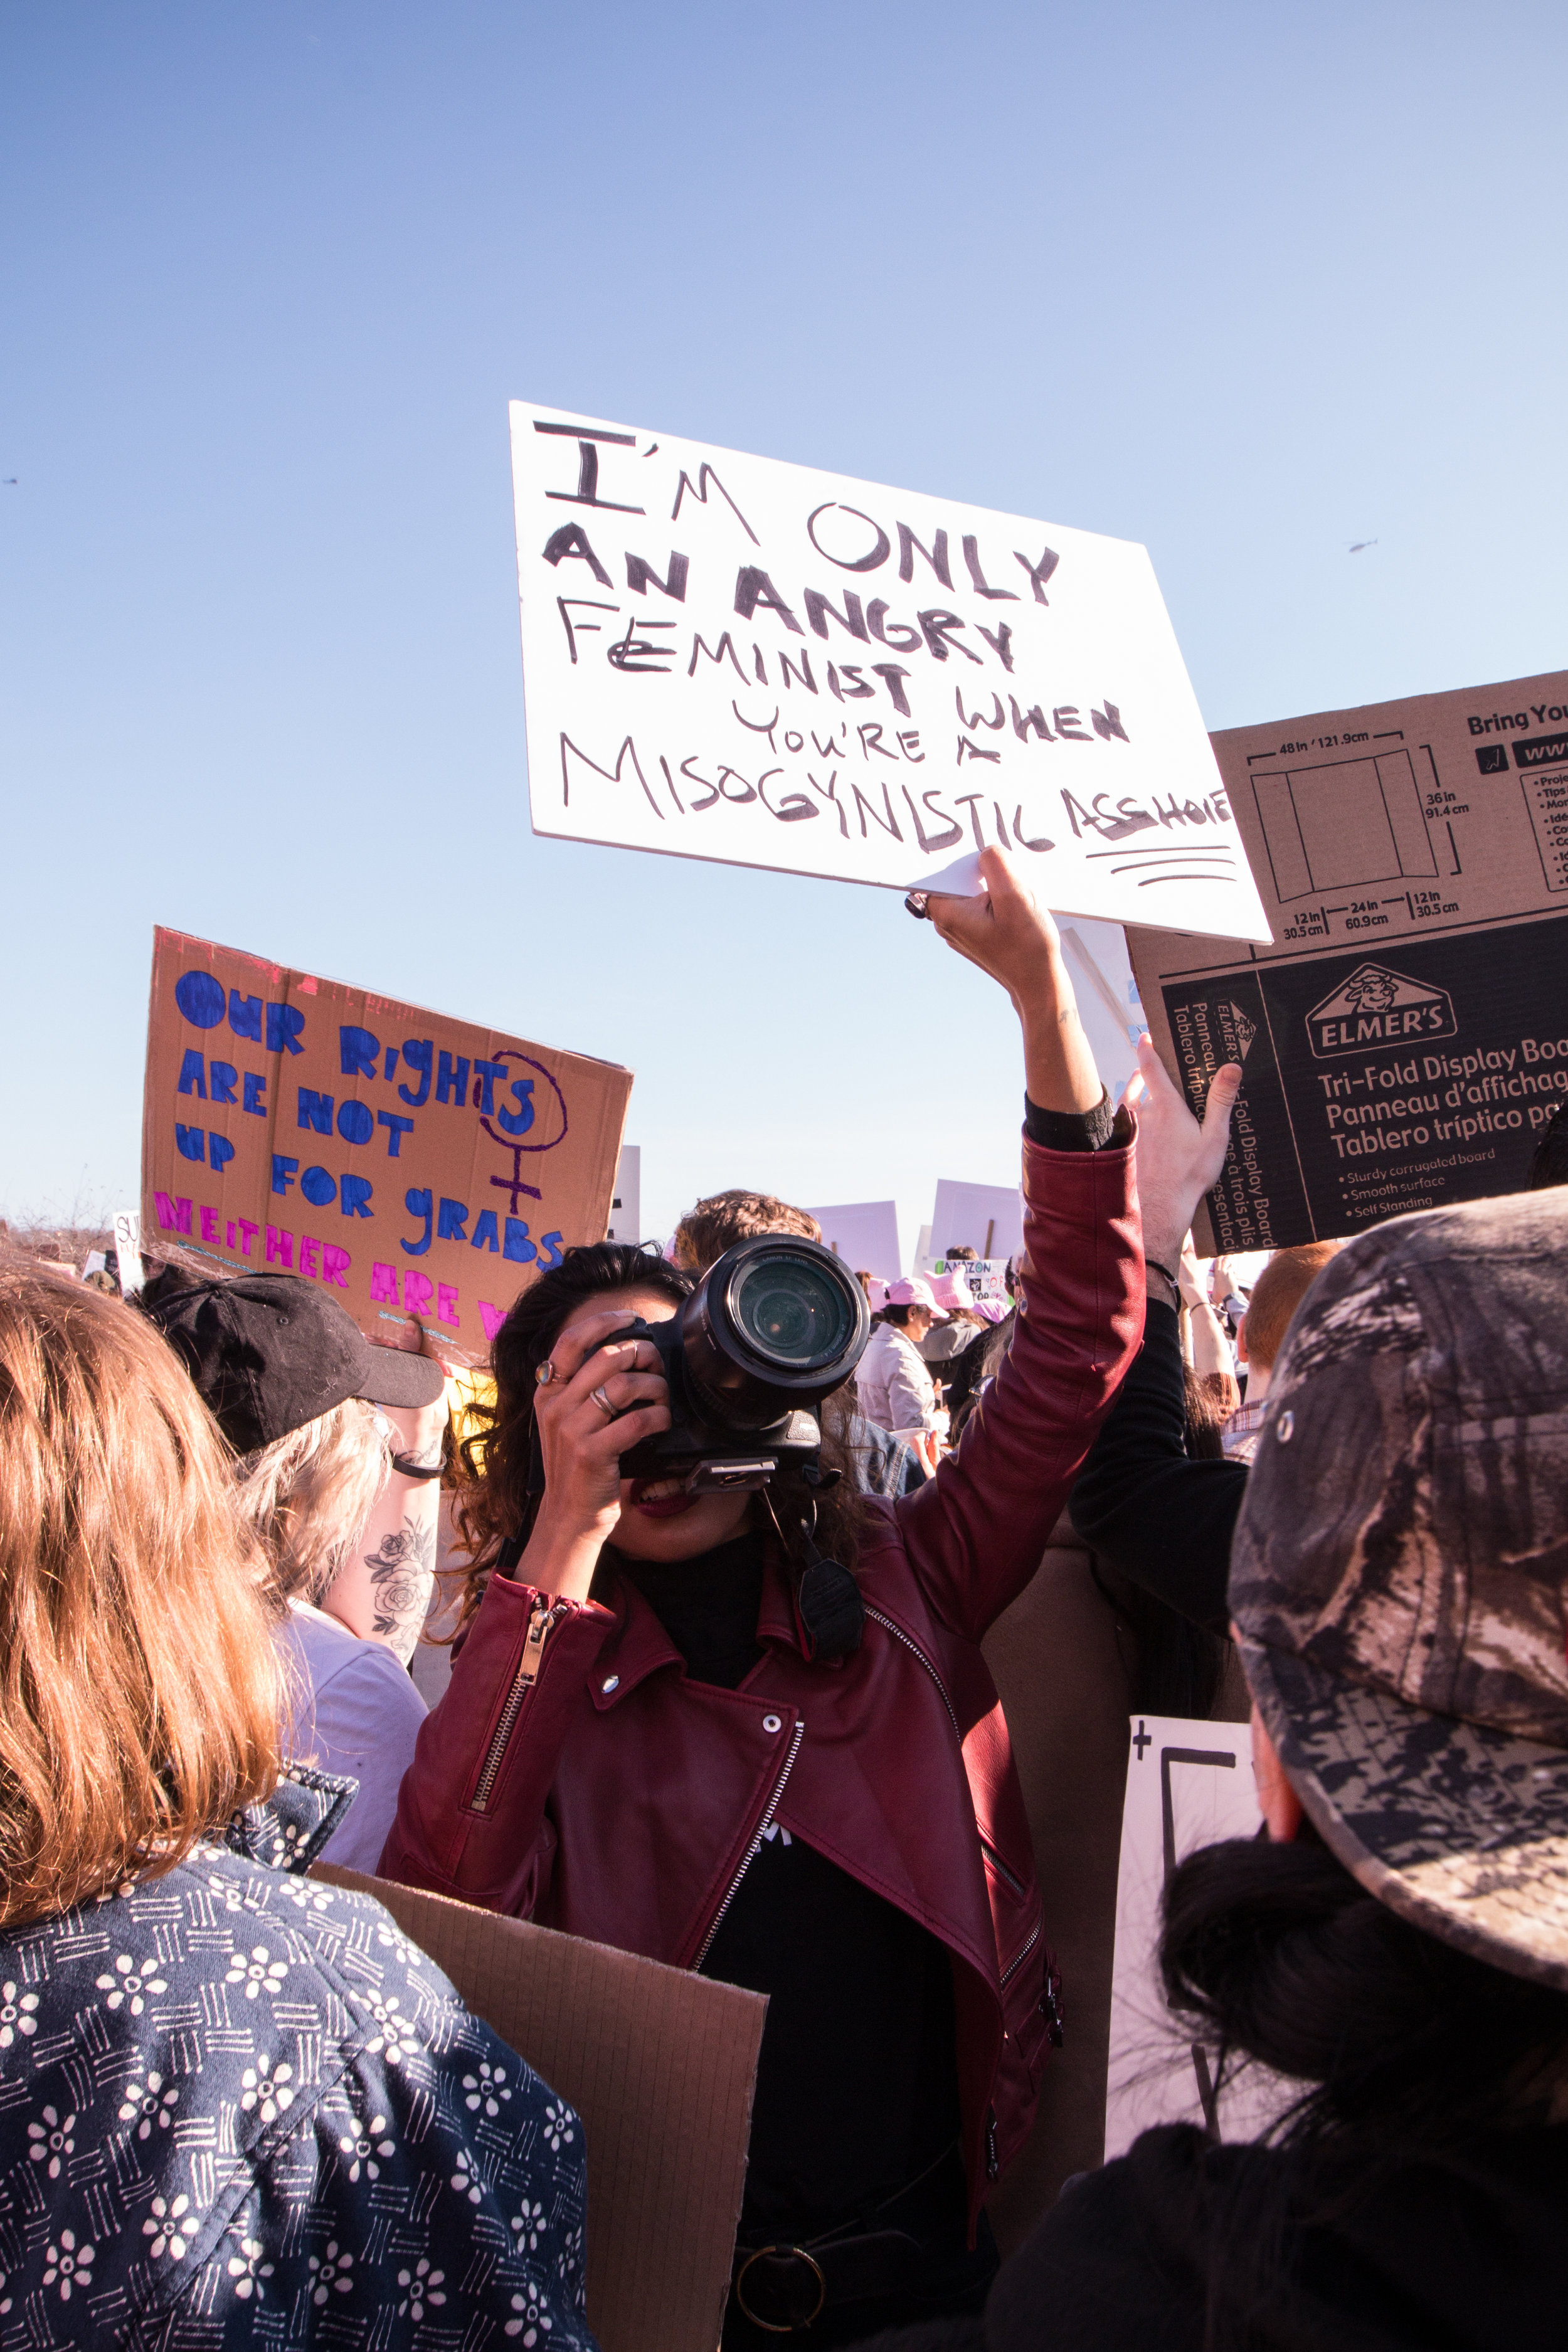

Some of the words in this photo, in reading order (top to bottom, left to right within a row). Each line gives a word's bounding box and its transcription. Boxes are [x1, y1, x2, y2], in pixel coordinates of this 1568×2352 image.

[533, 420, 761, 547] I'M
[807, 502, 1060, 607] ONLY
[541, 522, 689, 603] AN
[734, 565, 1015, 674] ANGRY
[557, 596, 911, 718] FEMINIST
[956, 686, 1130, 743] WHEN
[1467, 712, 1529, 736] Bring
[957, 735, 1000, 766] A
[559, 732, 1056, 854] MISOGYNISTIC
[1542, 787, 1565, 798] Tips
[1174, 1005, 1196, 1065] Tablero
[1192, 1002, 1217, 1073] Panneau
[1218, 1005, 1240, 1062] ELMER'S
[1322, 1005, 1444, 1047] ELMER'S
[1318, 1058, 1419, 1098] Tri-Fold
[1423, 1048, 1517, 1081] Display
[177, 1048, 273, 1118] ARE
[297, 1086, 414, 1158] NOT
[1326, 1094, 1439, 1128] Panneau
[1331, 1127, 1429, 1158] Tablero
[1434, 1110, 1522, 1141] tríptico
[272, 1153, 374, 1218] FOR
[1227, 1165, 1241, 1176] à
[1348, 1168, 1387, 1184] Sturdy
[1389, 1155, 1457, 1177] corrugated
[1458, 1148, 1496, 1165] board
[1350, 1184, 1398, 1201] Smooth
[1400, 1176, 1446, 1193] surface
[1230, 1178, 1249, 1215] trois
[1241, 1136, 1263, 1195] Display
[1254, 1197, 1278, 1249] Board
[1354, 1204, 1378, 1218] Self
[1379, 1196, 1433, 1214] Standing
[1235, 1217, 1256, 1246] plis
[370, 1261, 460, 1328] ARE
